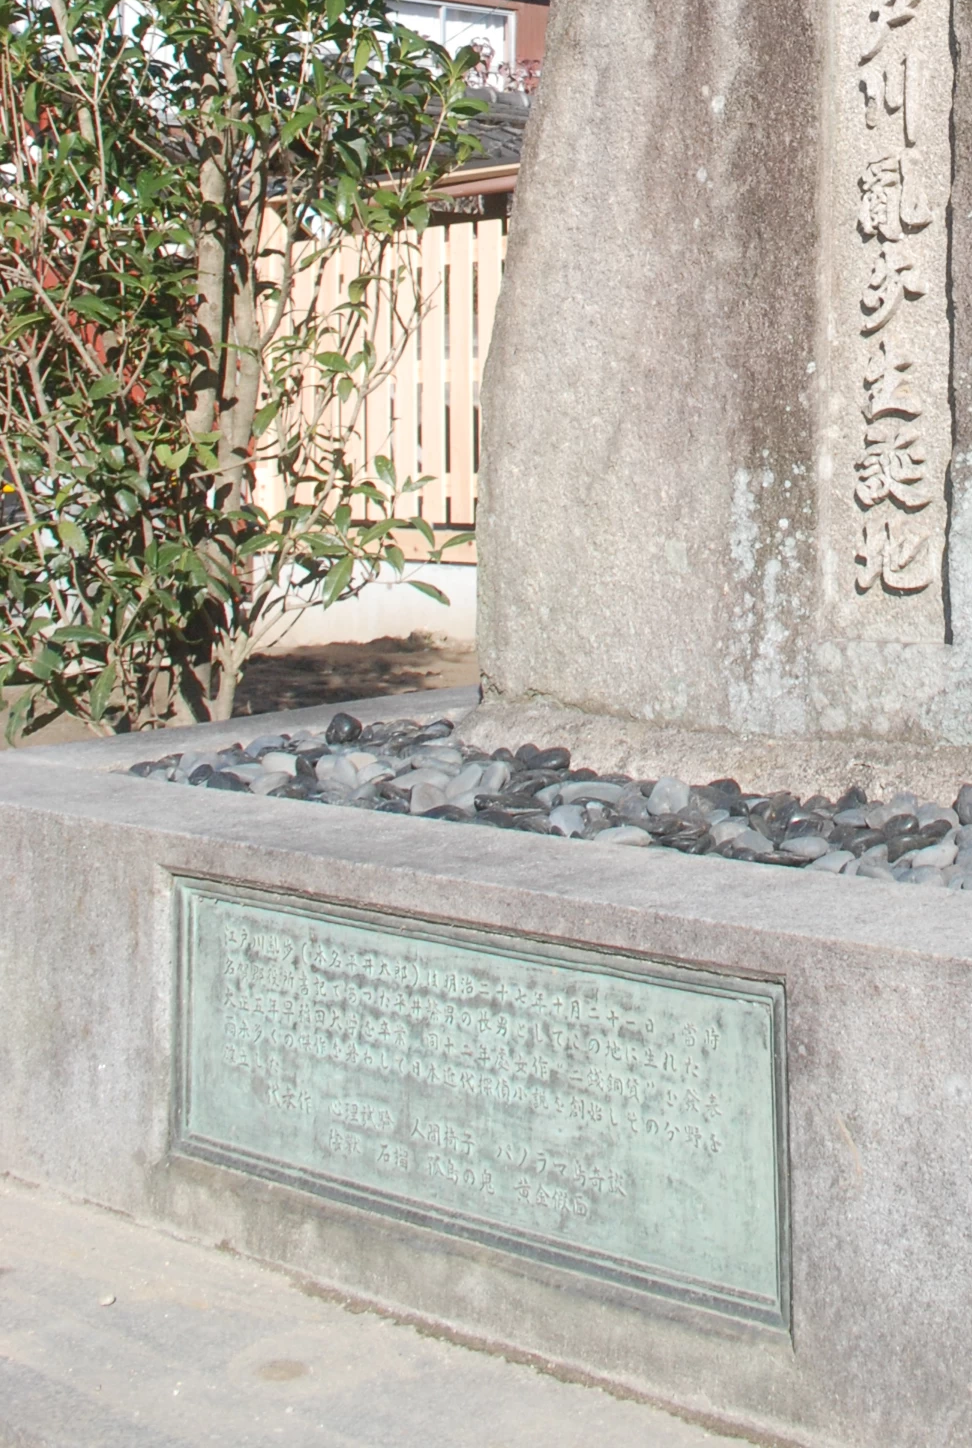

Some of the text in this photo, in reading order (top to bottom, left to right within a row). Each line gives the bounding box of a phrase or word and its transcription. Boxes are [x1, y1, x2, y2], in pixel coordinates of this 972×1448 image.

[409, 1115, 475, 1158] 人間椅子
[426, 1151, 496, 1196] 孤島の鬼
